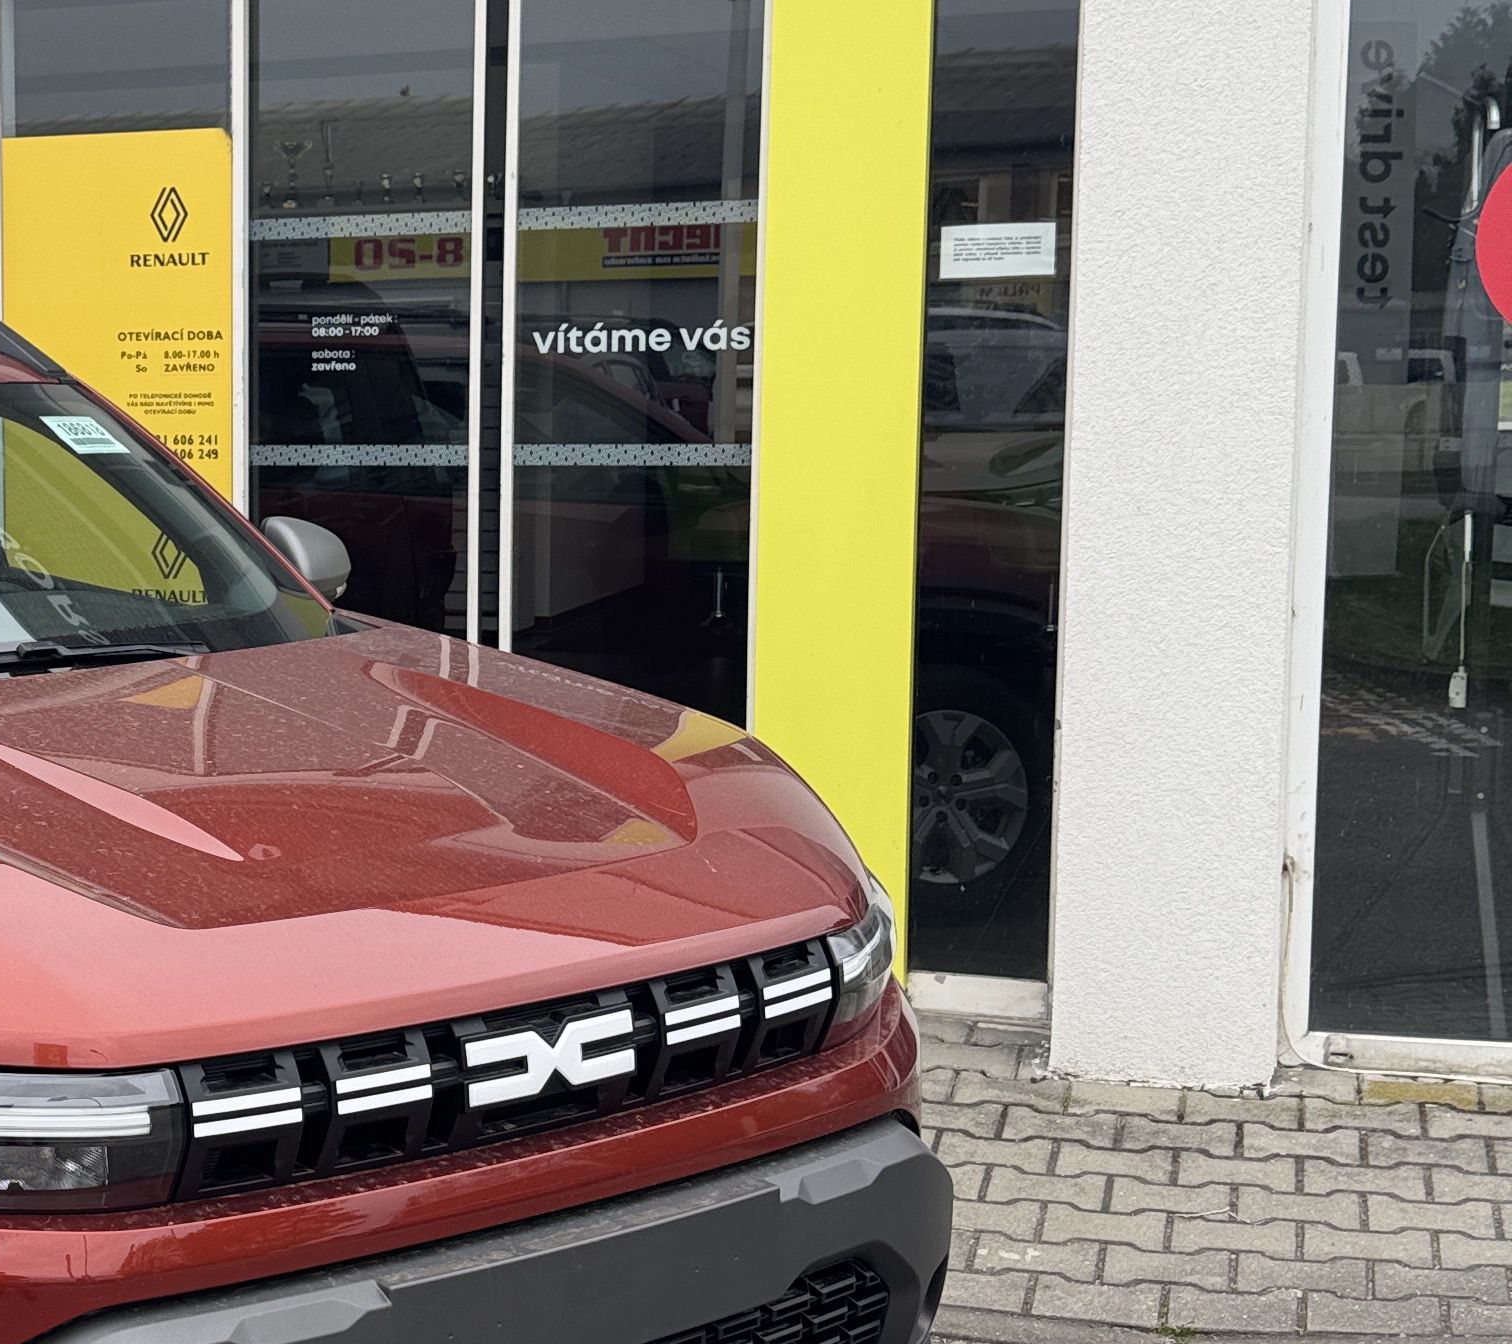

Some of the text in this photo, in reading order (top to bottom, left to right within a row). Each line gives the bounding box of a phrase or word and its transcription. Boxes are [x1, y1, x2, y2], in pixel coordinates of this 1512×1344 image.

[129, 252, 210, 268] RENAULT
[311, 314, 353, 326] pondělí
[117, 328, 224, 341] OTEVÍRACÍ DOBA
[311, 327, 344, 337] 08:00
[350, 326, 379, 337] 17:00
[532, 320, 751, 355] vítáme vás
[120, 350, 148, 360] Po-Pá
[135, 362, 216, 373] So ZAVŘENO
[311, 360, 357, 371] zavřeno
[173, 434, 194, 446] 606
[198, 434, 218, 446] 241
[198, 448, 219, 460] 249
